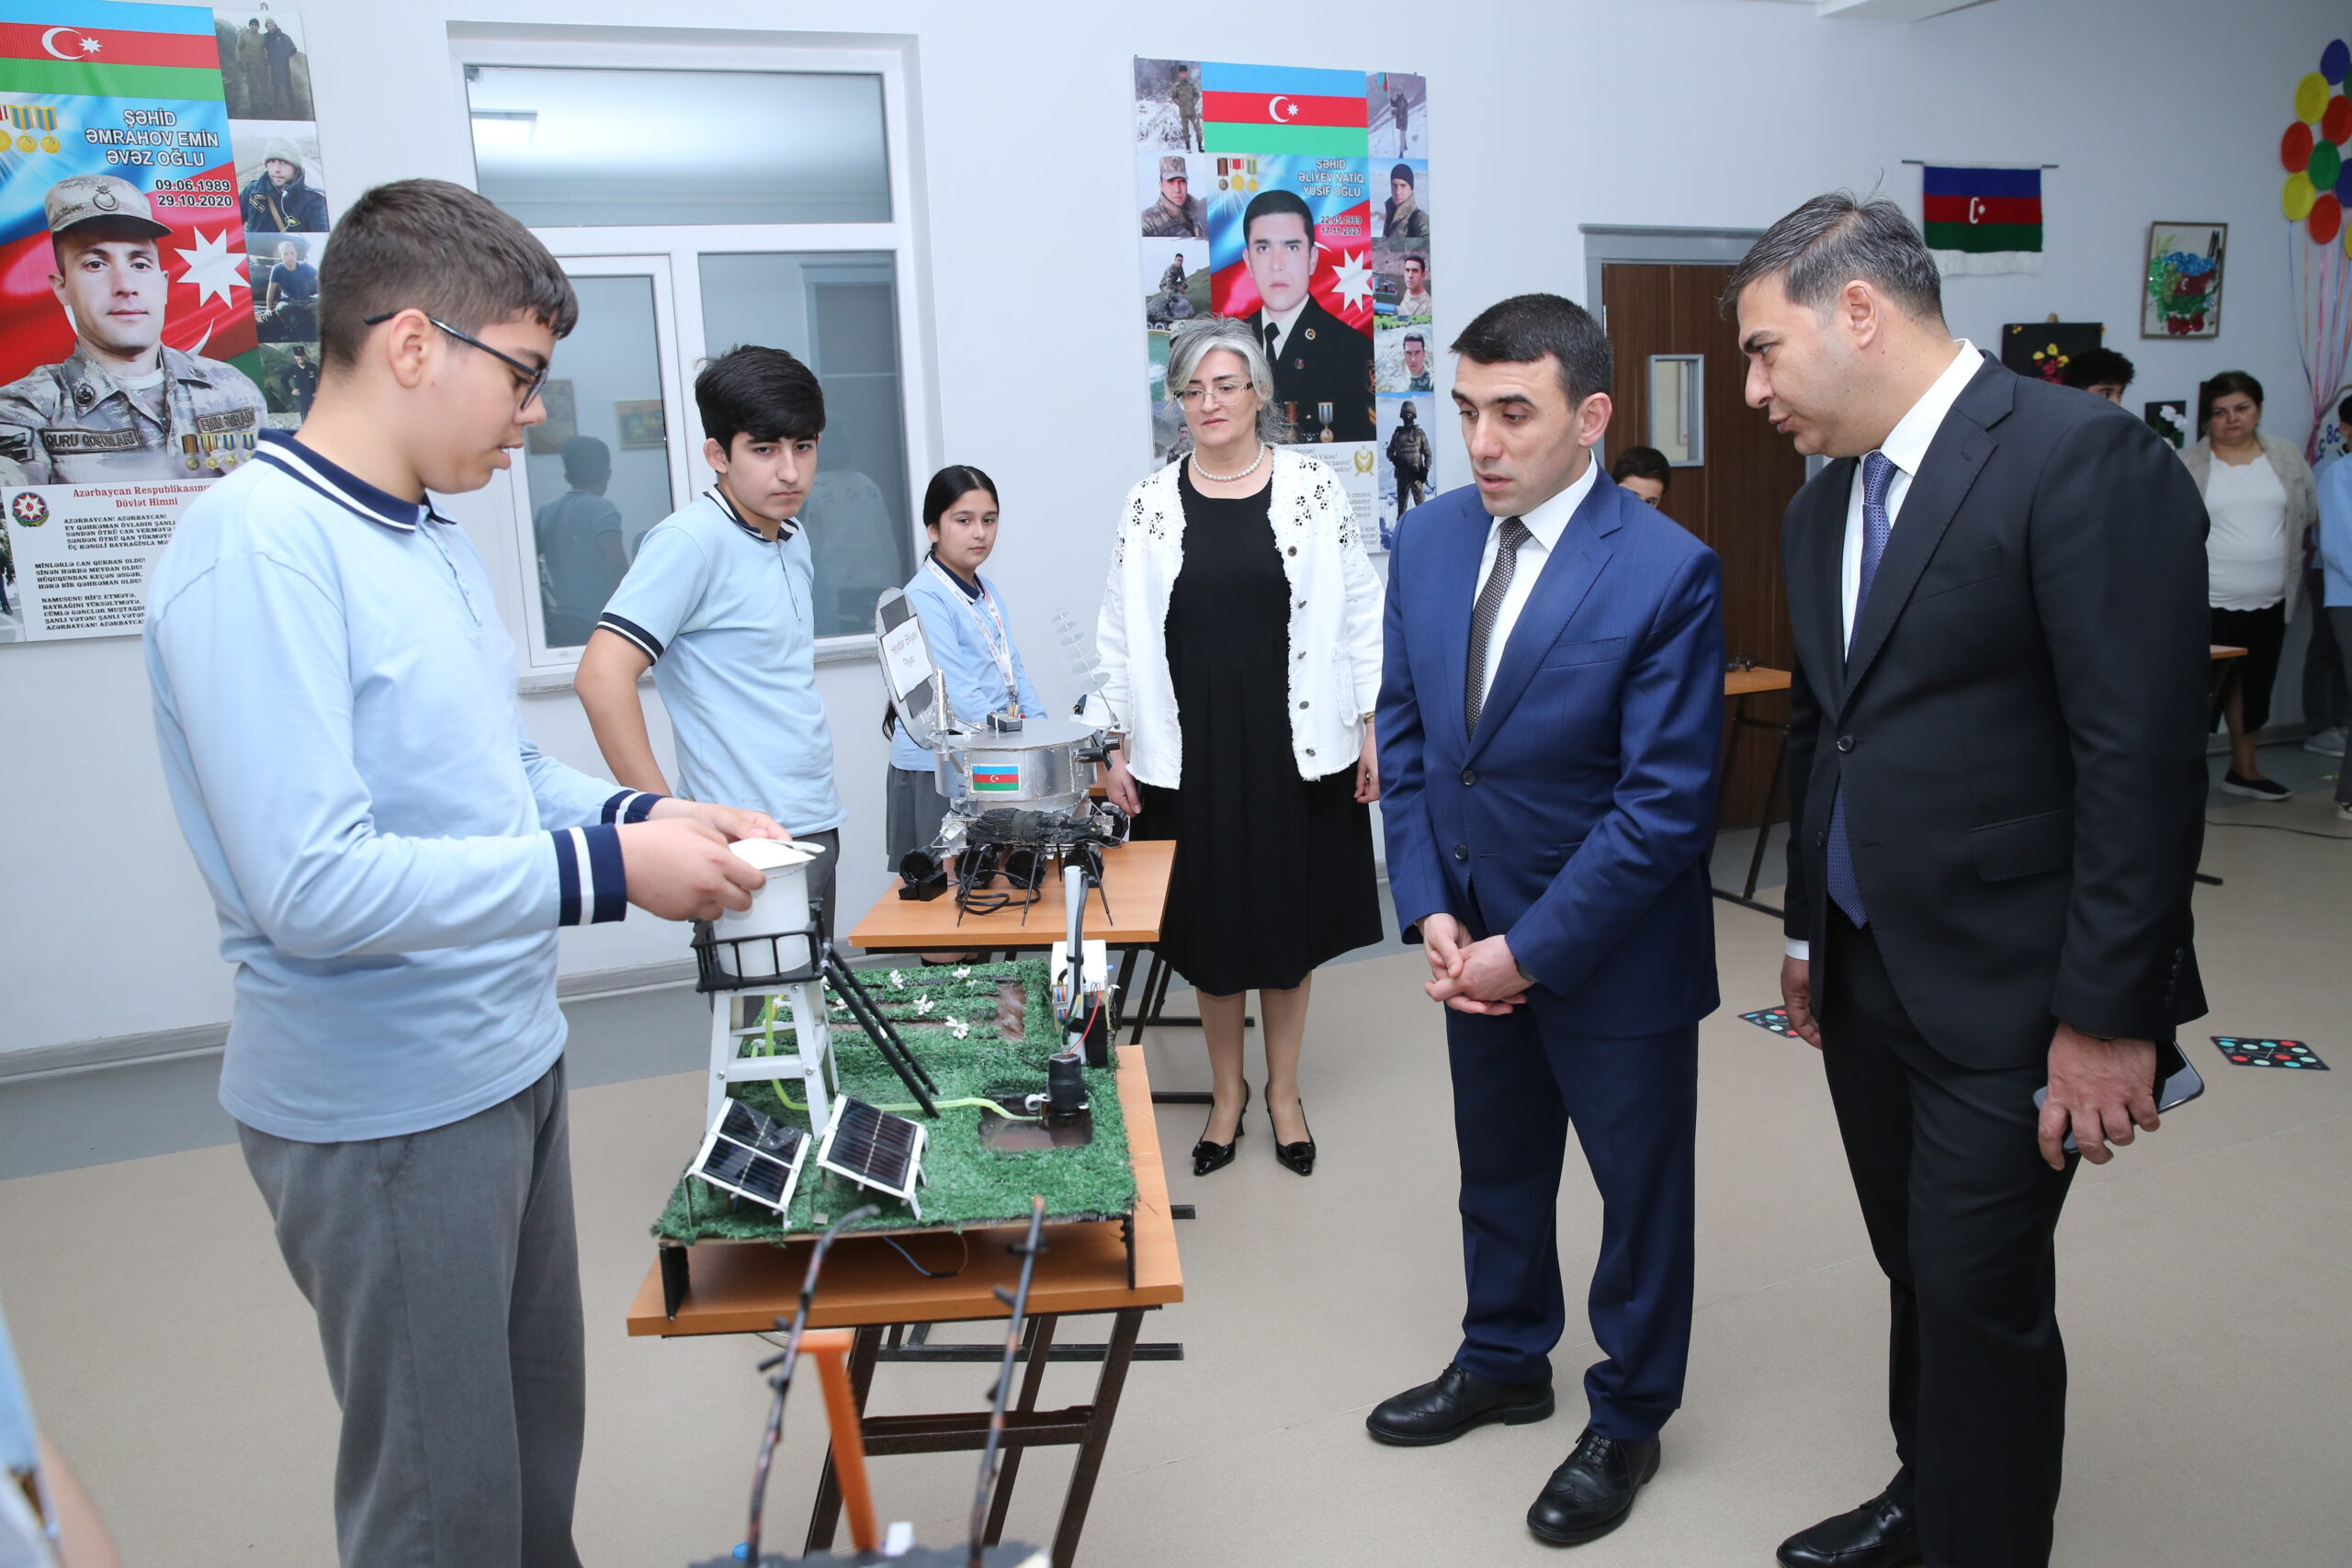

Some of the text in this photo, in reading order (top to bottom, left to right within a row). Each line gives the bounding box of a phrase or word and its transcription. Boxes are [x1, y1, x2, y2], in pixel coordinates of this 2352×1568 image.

[123, 107, 176, 128] ŞƏHİD
[85, 128, 220, 147] ƏMRAHOV EMİN
[107, 148, 205, 166] ƏVƏZ OĞLU
[1317, 158, 1346, 170] ŞƏHİD
[1298, 172, 1333, 183] ƏLİYEV
[155, 179, 231, 191] 09.06.1989
[1303, 184, 1361, 197] YUSİF OĞLU
[157, 195, 232, 207] 29.10.2020
[46, 434, 79, 447] QURU
[73, 488, 132, 498] Azərbaycan
[116, 497, 178, 508] Dövlət Himni
